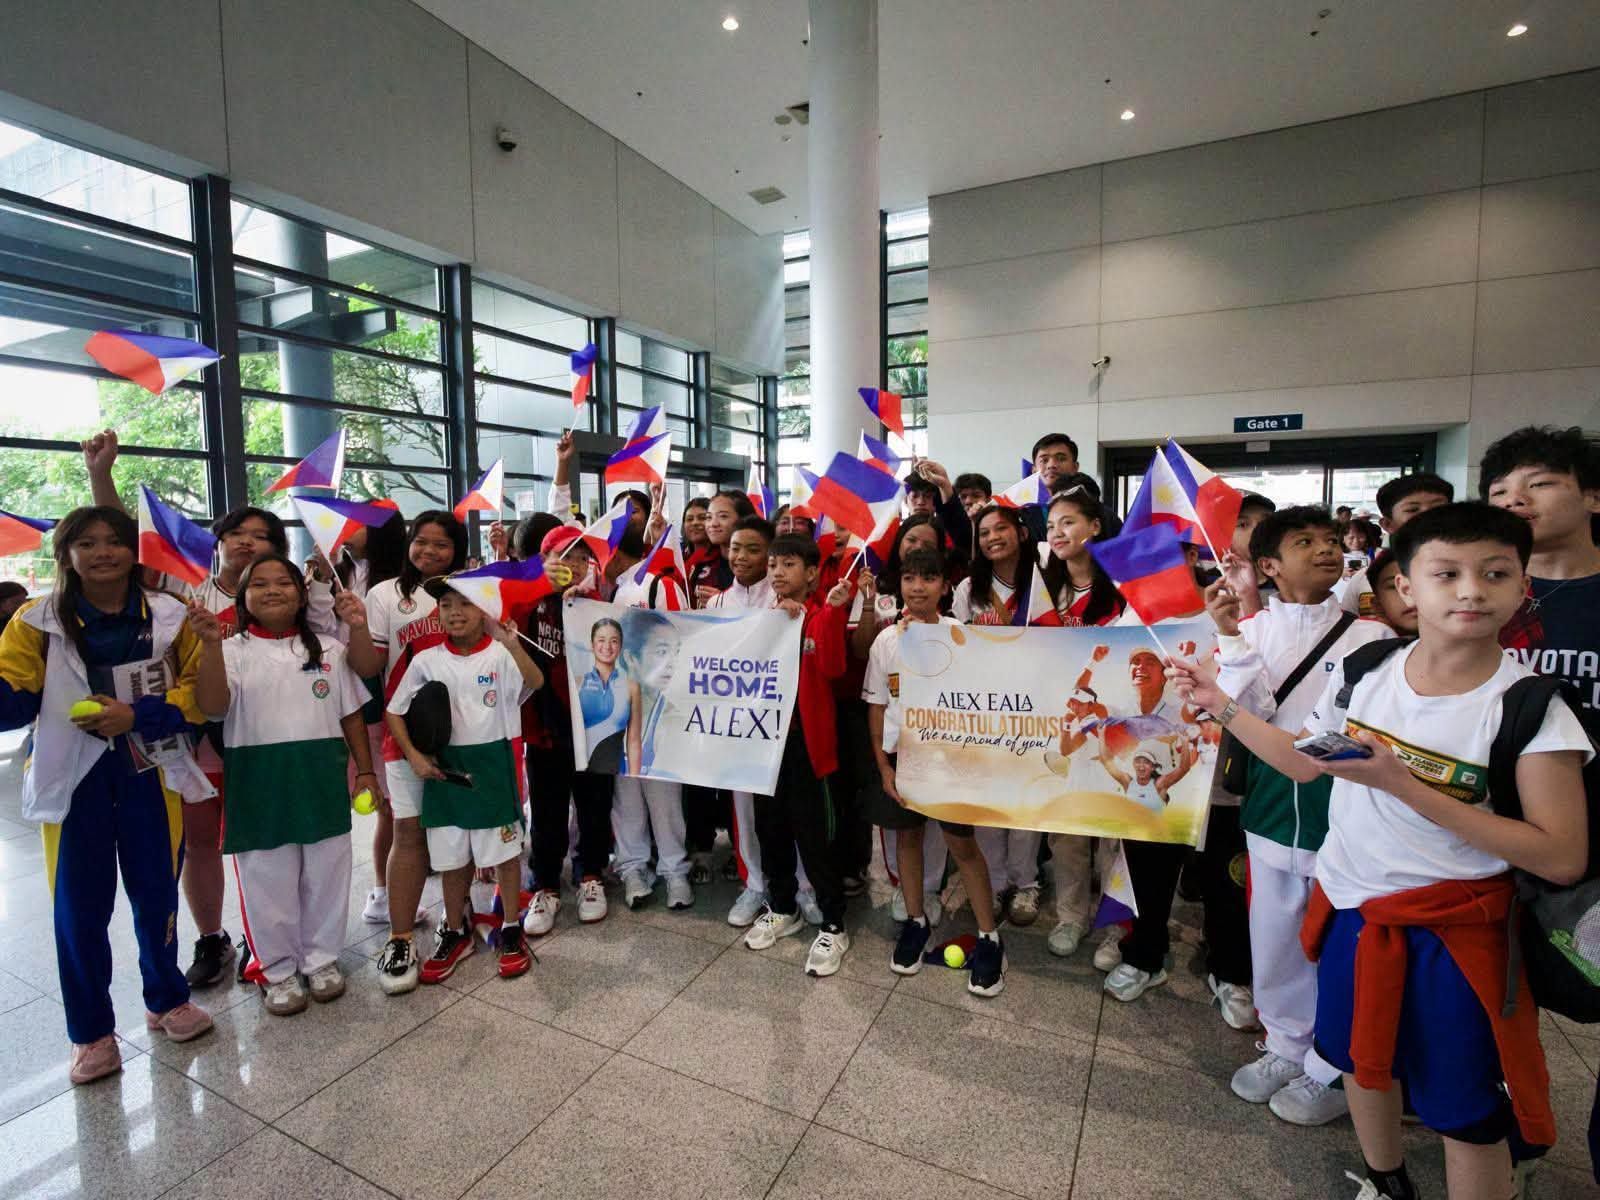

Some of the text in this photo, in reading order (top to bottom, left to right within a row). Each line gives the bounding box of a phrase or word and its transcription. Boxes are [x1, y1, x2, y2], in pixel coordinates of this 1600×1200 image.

[1247, 417, 1289, 429] Gate 1
[692, 655, 780, 674] WELCOME
[689, 672, 783, 703] HOME,
[937, 691, 1034, 712] ALEX EALA
[684, 704, 781, 740] ALEX!
[918, 727, 1052, 756] We are proud of you!
